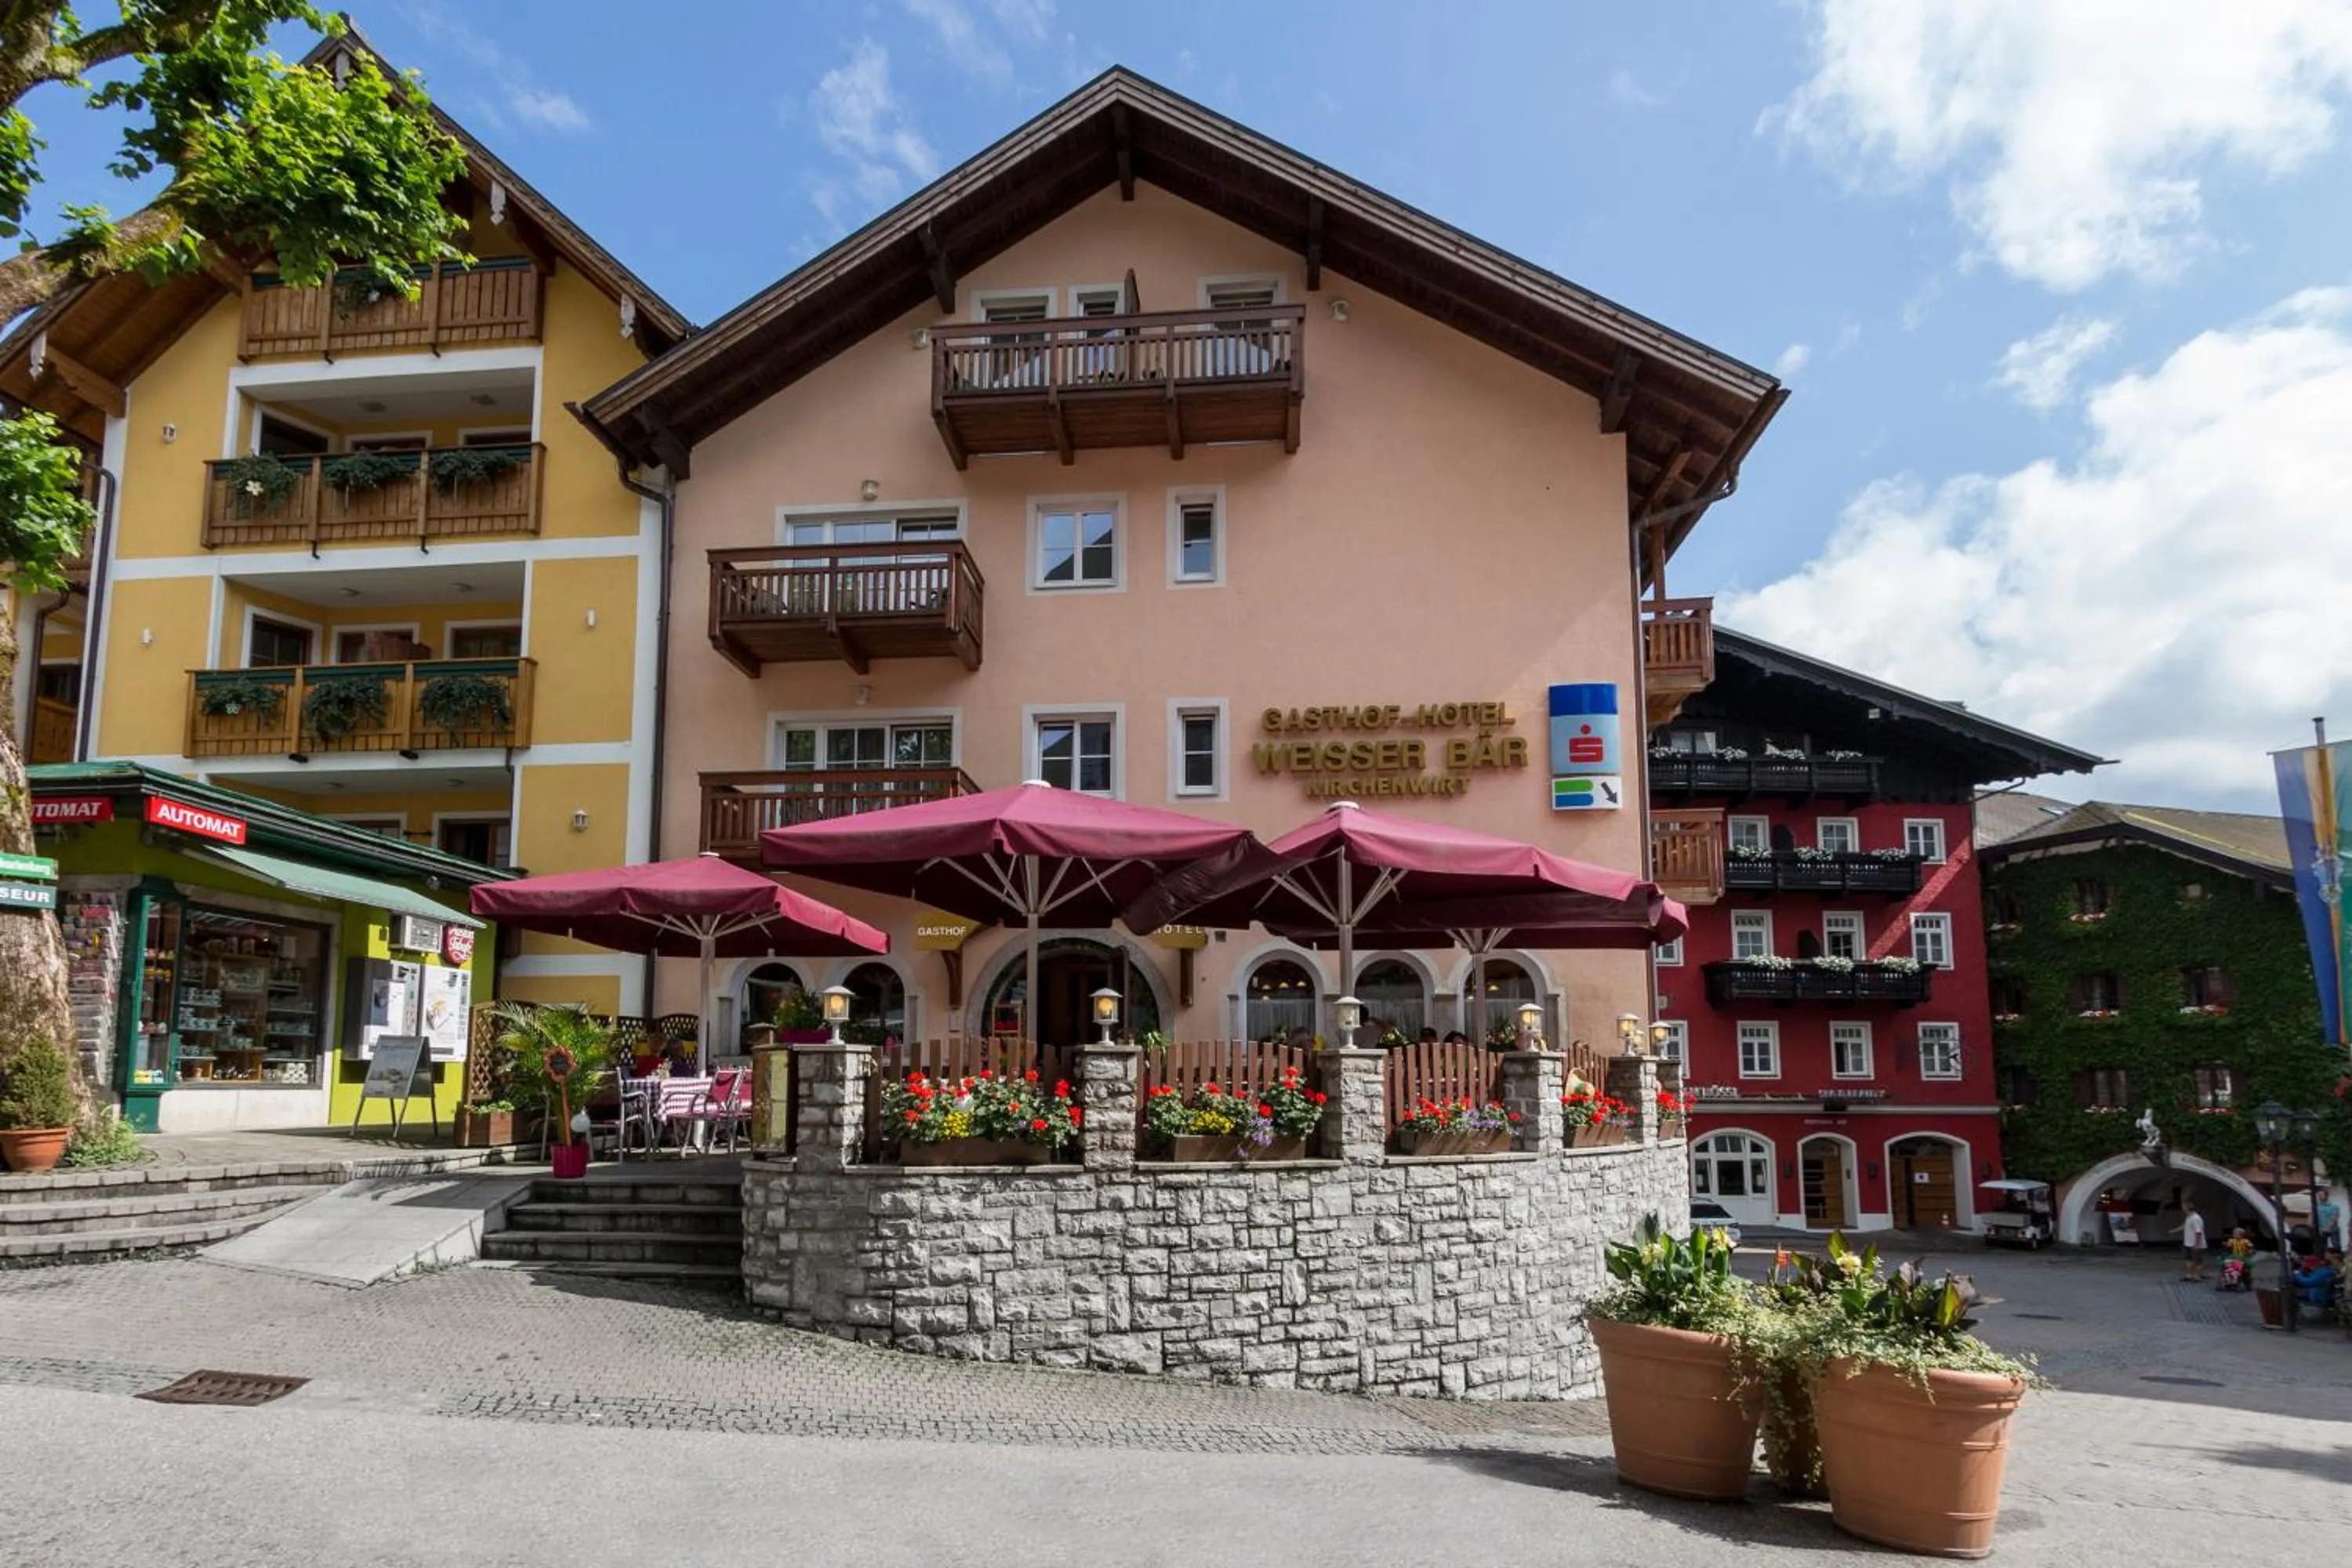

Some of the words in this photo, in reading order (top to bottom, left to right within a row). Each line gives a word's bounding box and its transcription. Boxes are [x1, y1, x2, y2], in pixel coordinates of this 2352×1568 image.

[1263, 706, 1400, 731] GASTHOF
[1420, 702, 1516, 726] HOTEL
[1252, 740, 1425, 773] WEISSER
[1447, 730, 1528, 768] BÄR
[1306, 776, 1470, 797] KIRCHENWIRT
[31, 802, 102, 818] TOMAT
[158, 804, 241, 837] AUTOMAT
[917, 926, 967, 935] GASTHOF
